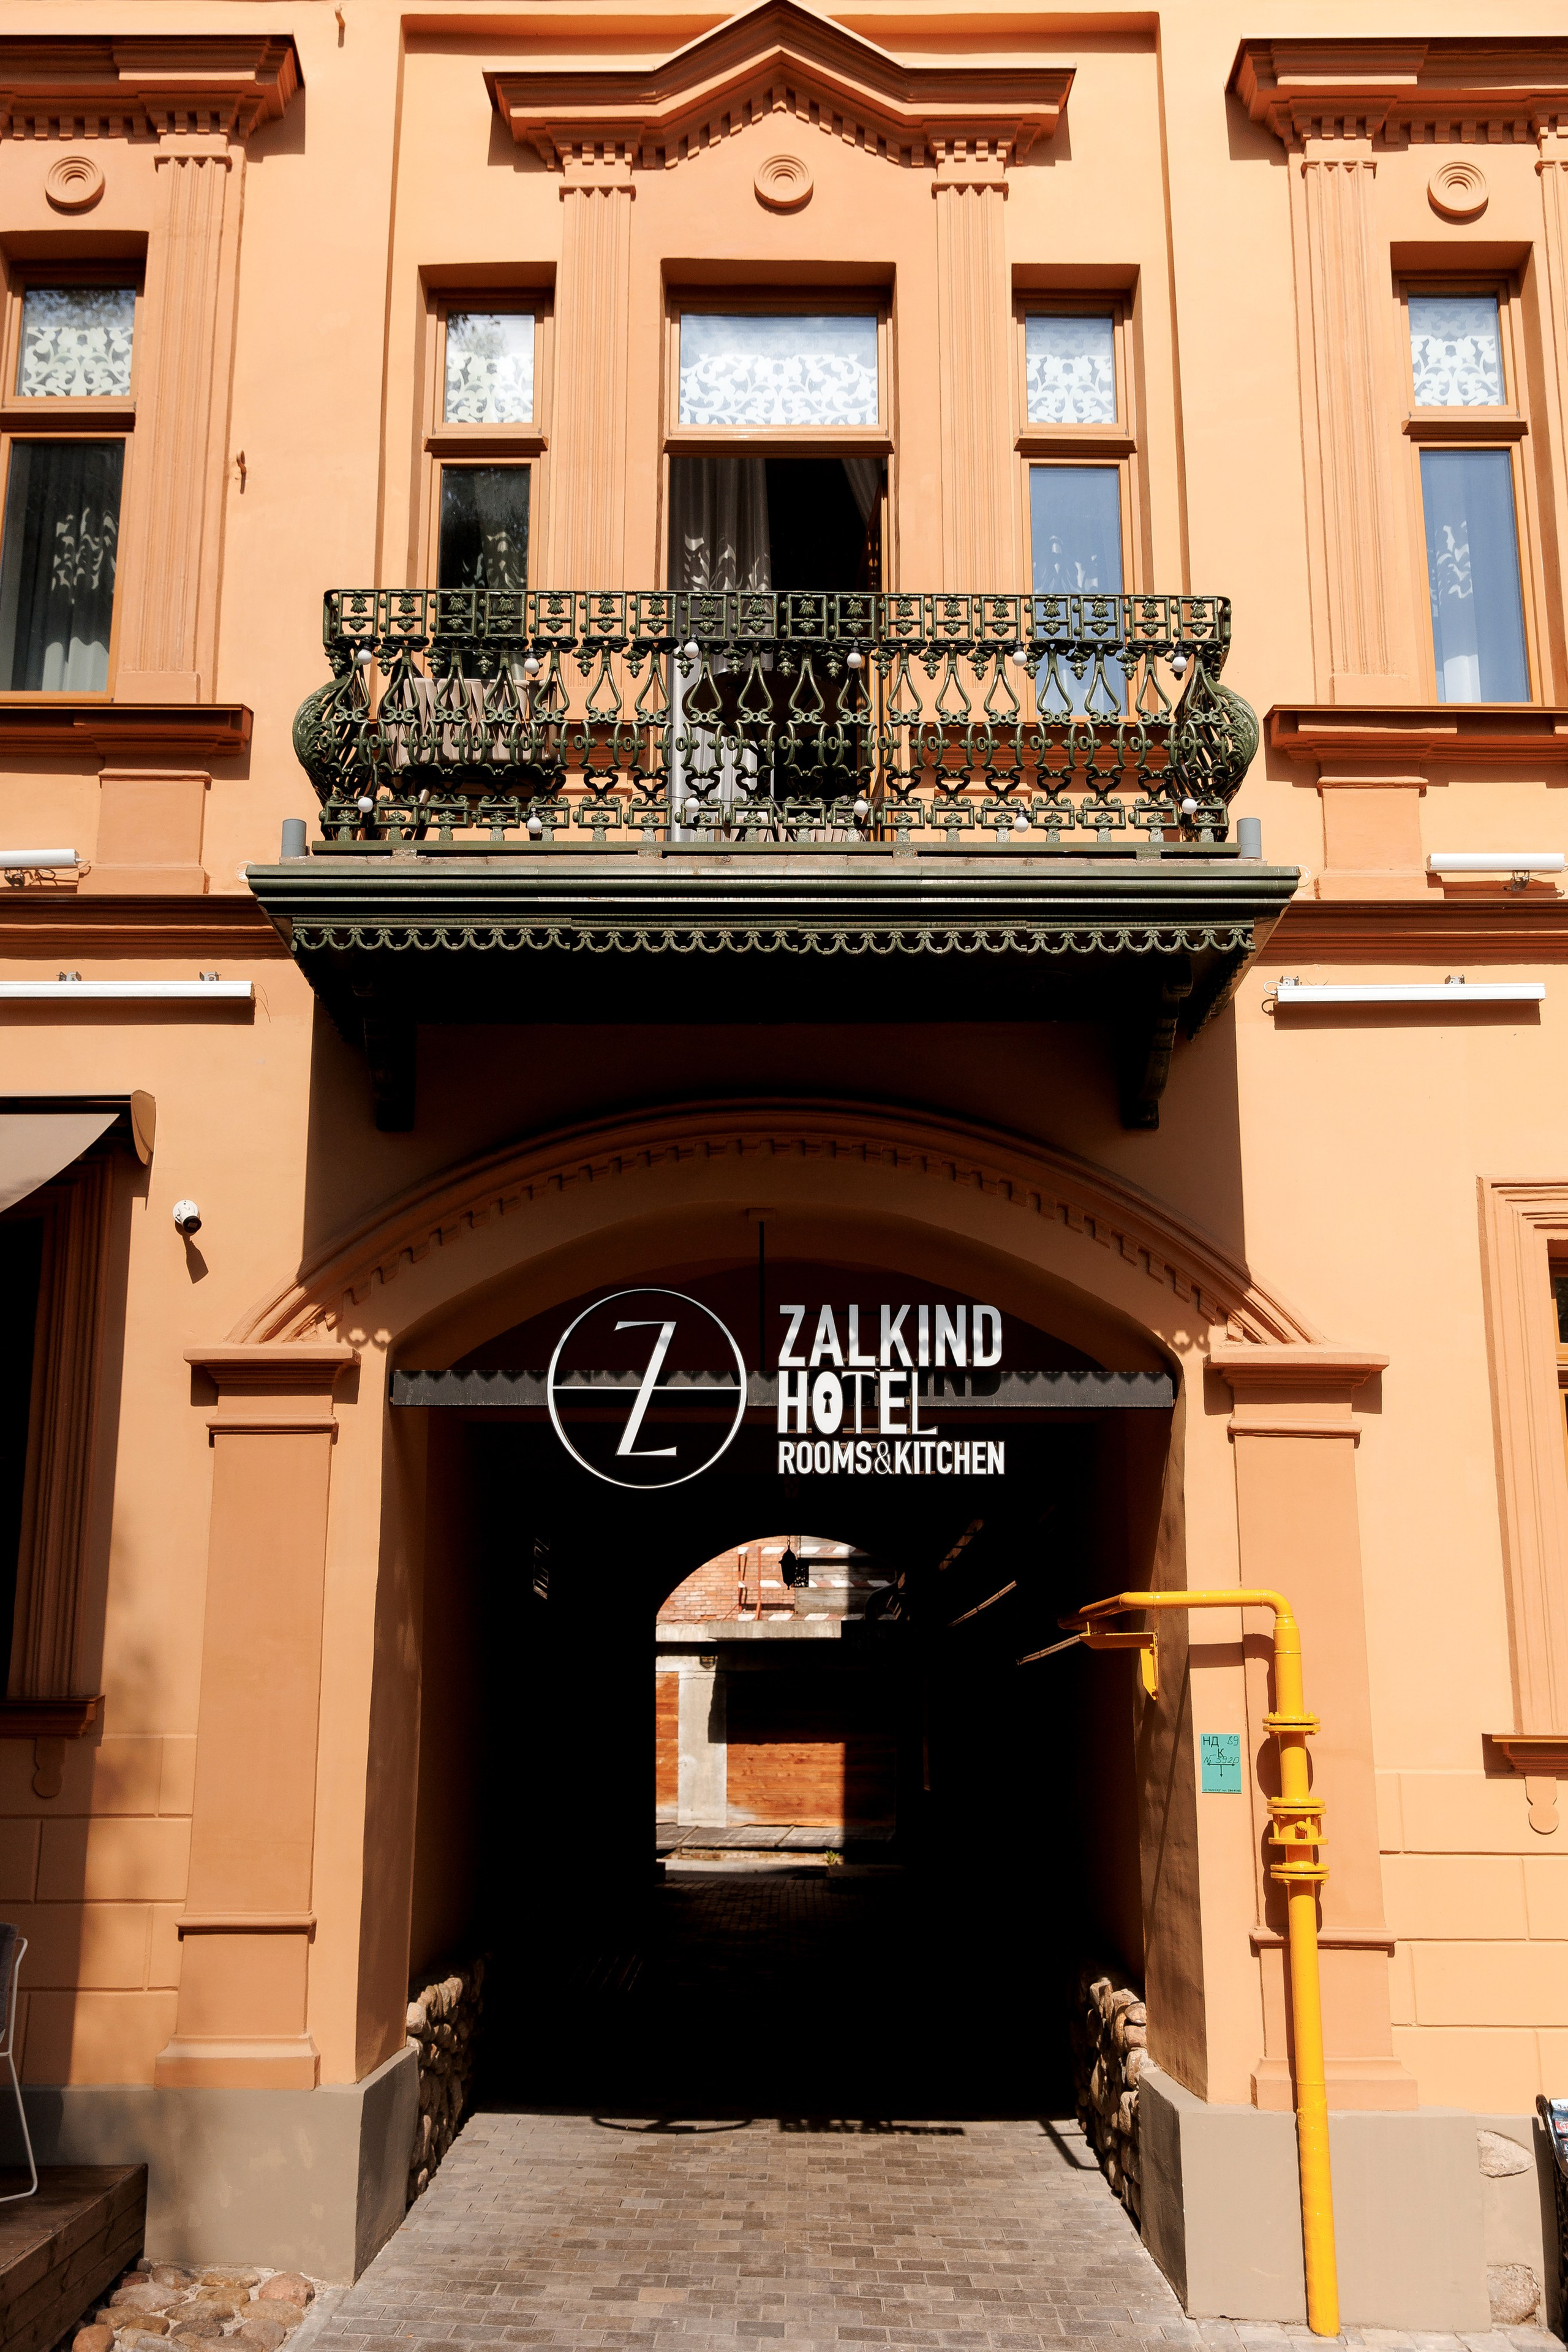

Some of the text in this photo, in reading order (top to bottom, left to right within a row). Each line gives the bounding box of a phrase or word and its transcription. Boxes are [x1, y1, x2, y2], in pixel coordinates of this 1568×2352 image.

[778, 1303, 1003, 1367] ZALKIND
[777, 1370, 938, 1435] HOTEL
[778, 1441, 1005, 1475] ROOMS&KITCHEN
[1203, 1736, 1219, 1747] НД
